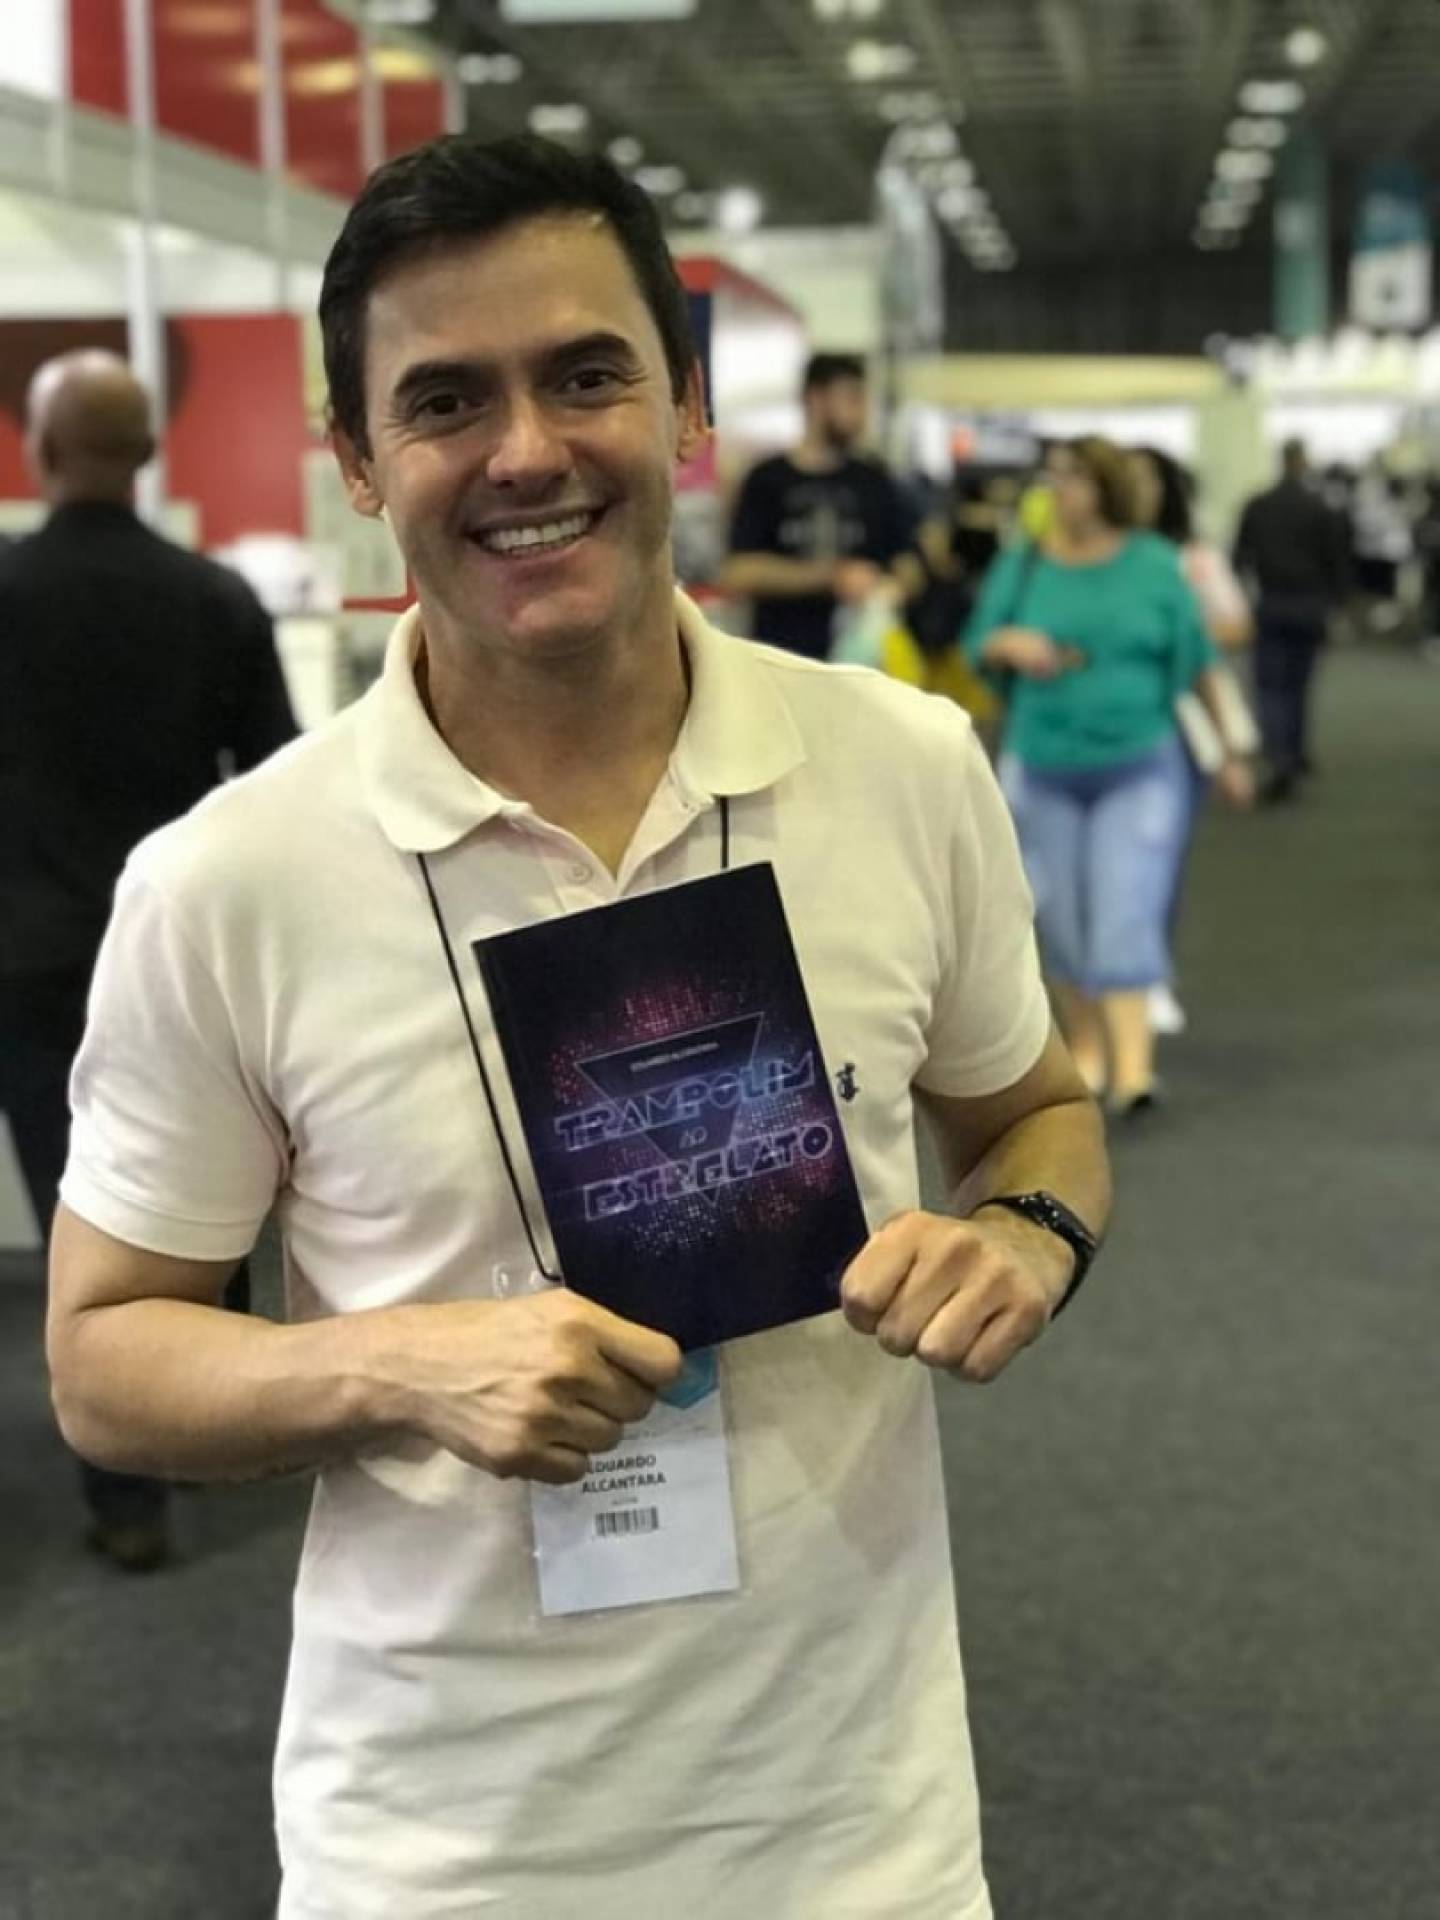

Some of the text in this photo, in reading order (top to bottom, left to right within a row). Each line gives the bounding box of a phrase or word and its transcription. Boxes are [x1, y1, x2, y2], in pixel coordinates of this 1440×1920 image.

[555, 1050, 815, 1151] TRAMPOLIM
[583, 1122, 833, 1221] ESTRELATO
[582, 1472, 667, 1493] ALCANTARA
